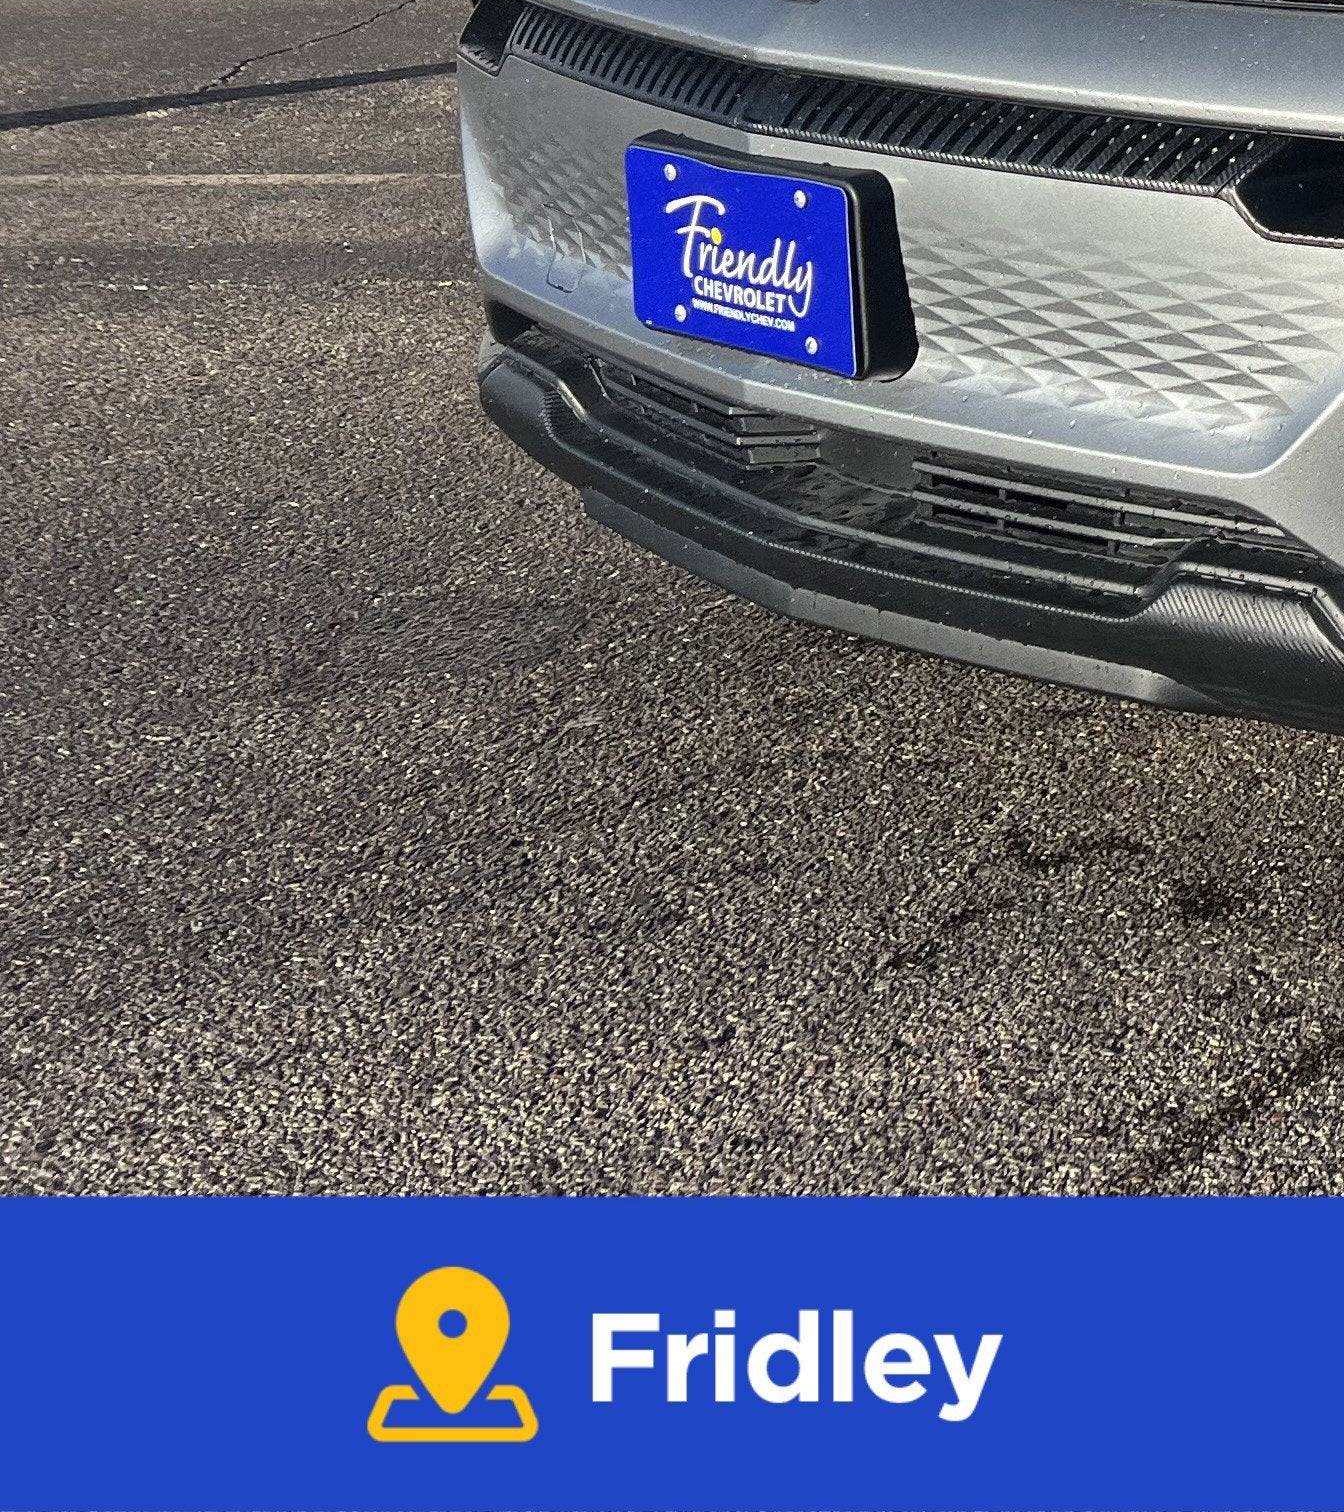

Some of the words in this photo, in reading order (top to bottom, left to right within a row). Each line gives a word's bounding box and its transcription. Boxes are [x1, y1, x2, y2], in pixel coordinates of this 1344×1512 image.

[665, 194, 814, 318] Friendly
[693, 275, 787, 314] CHEVROLET
[691, 297, 796, 333] WWW.FRIENDLYCHEV.COM
